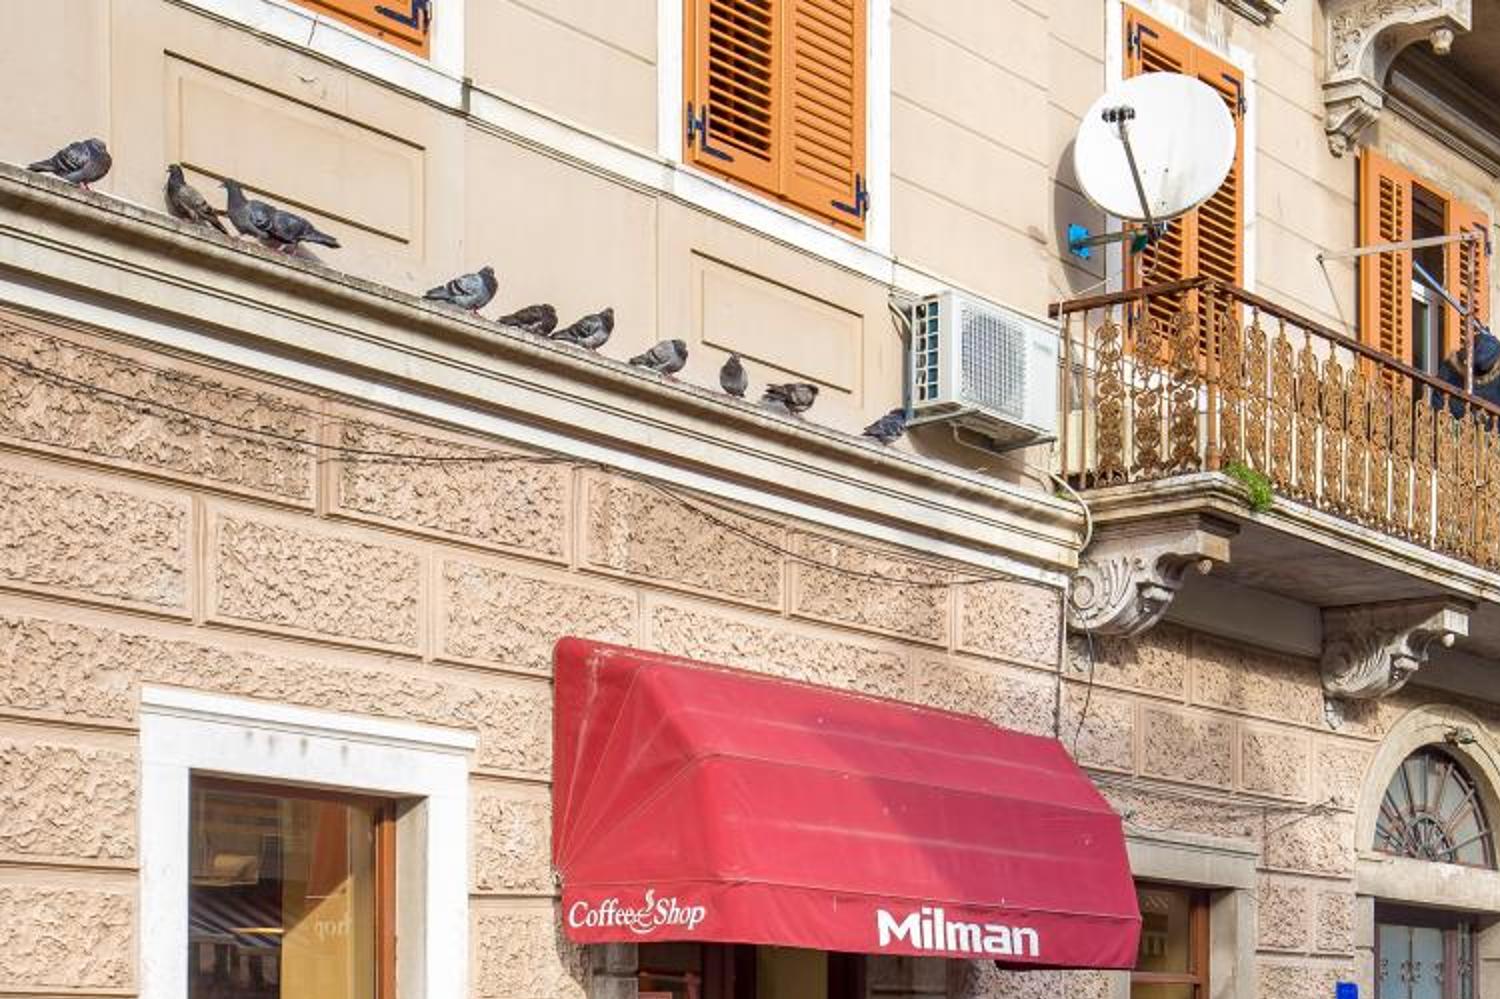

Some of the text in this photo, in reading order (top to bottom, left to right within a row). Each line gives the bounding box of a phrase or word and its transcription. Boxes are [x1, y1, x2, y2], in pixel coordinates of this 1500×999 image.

[568, 897, 706, 931] Coffee Shop
[876, 906, 1040, 957] Milman
